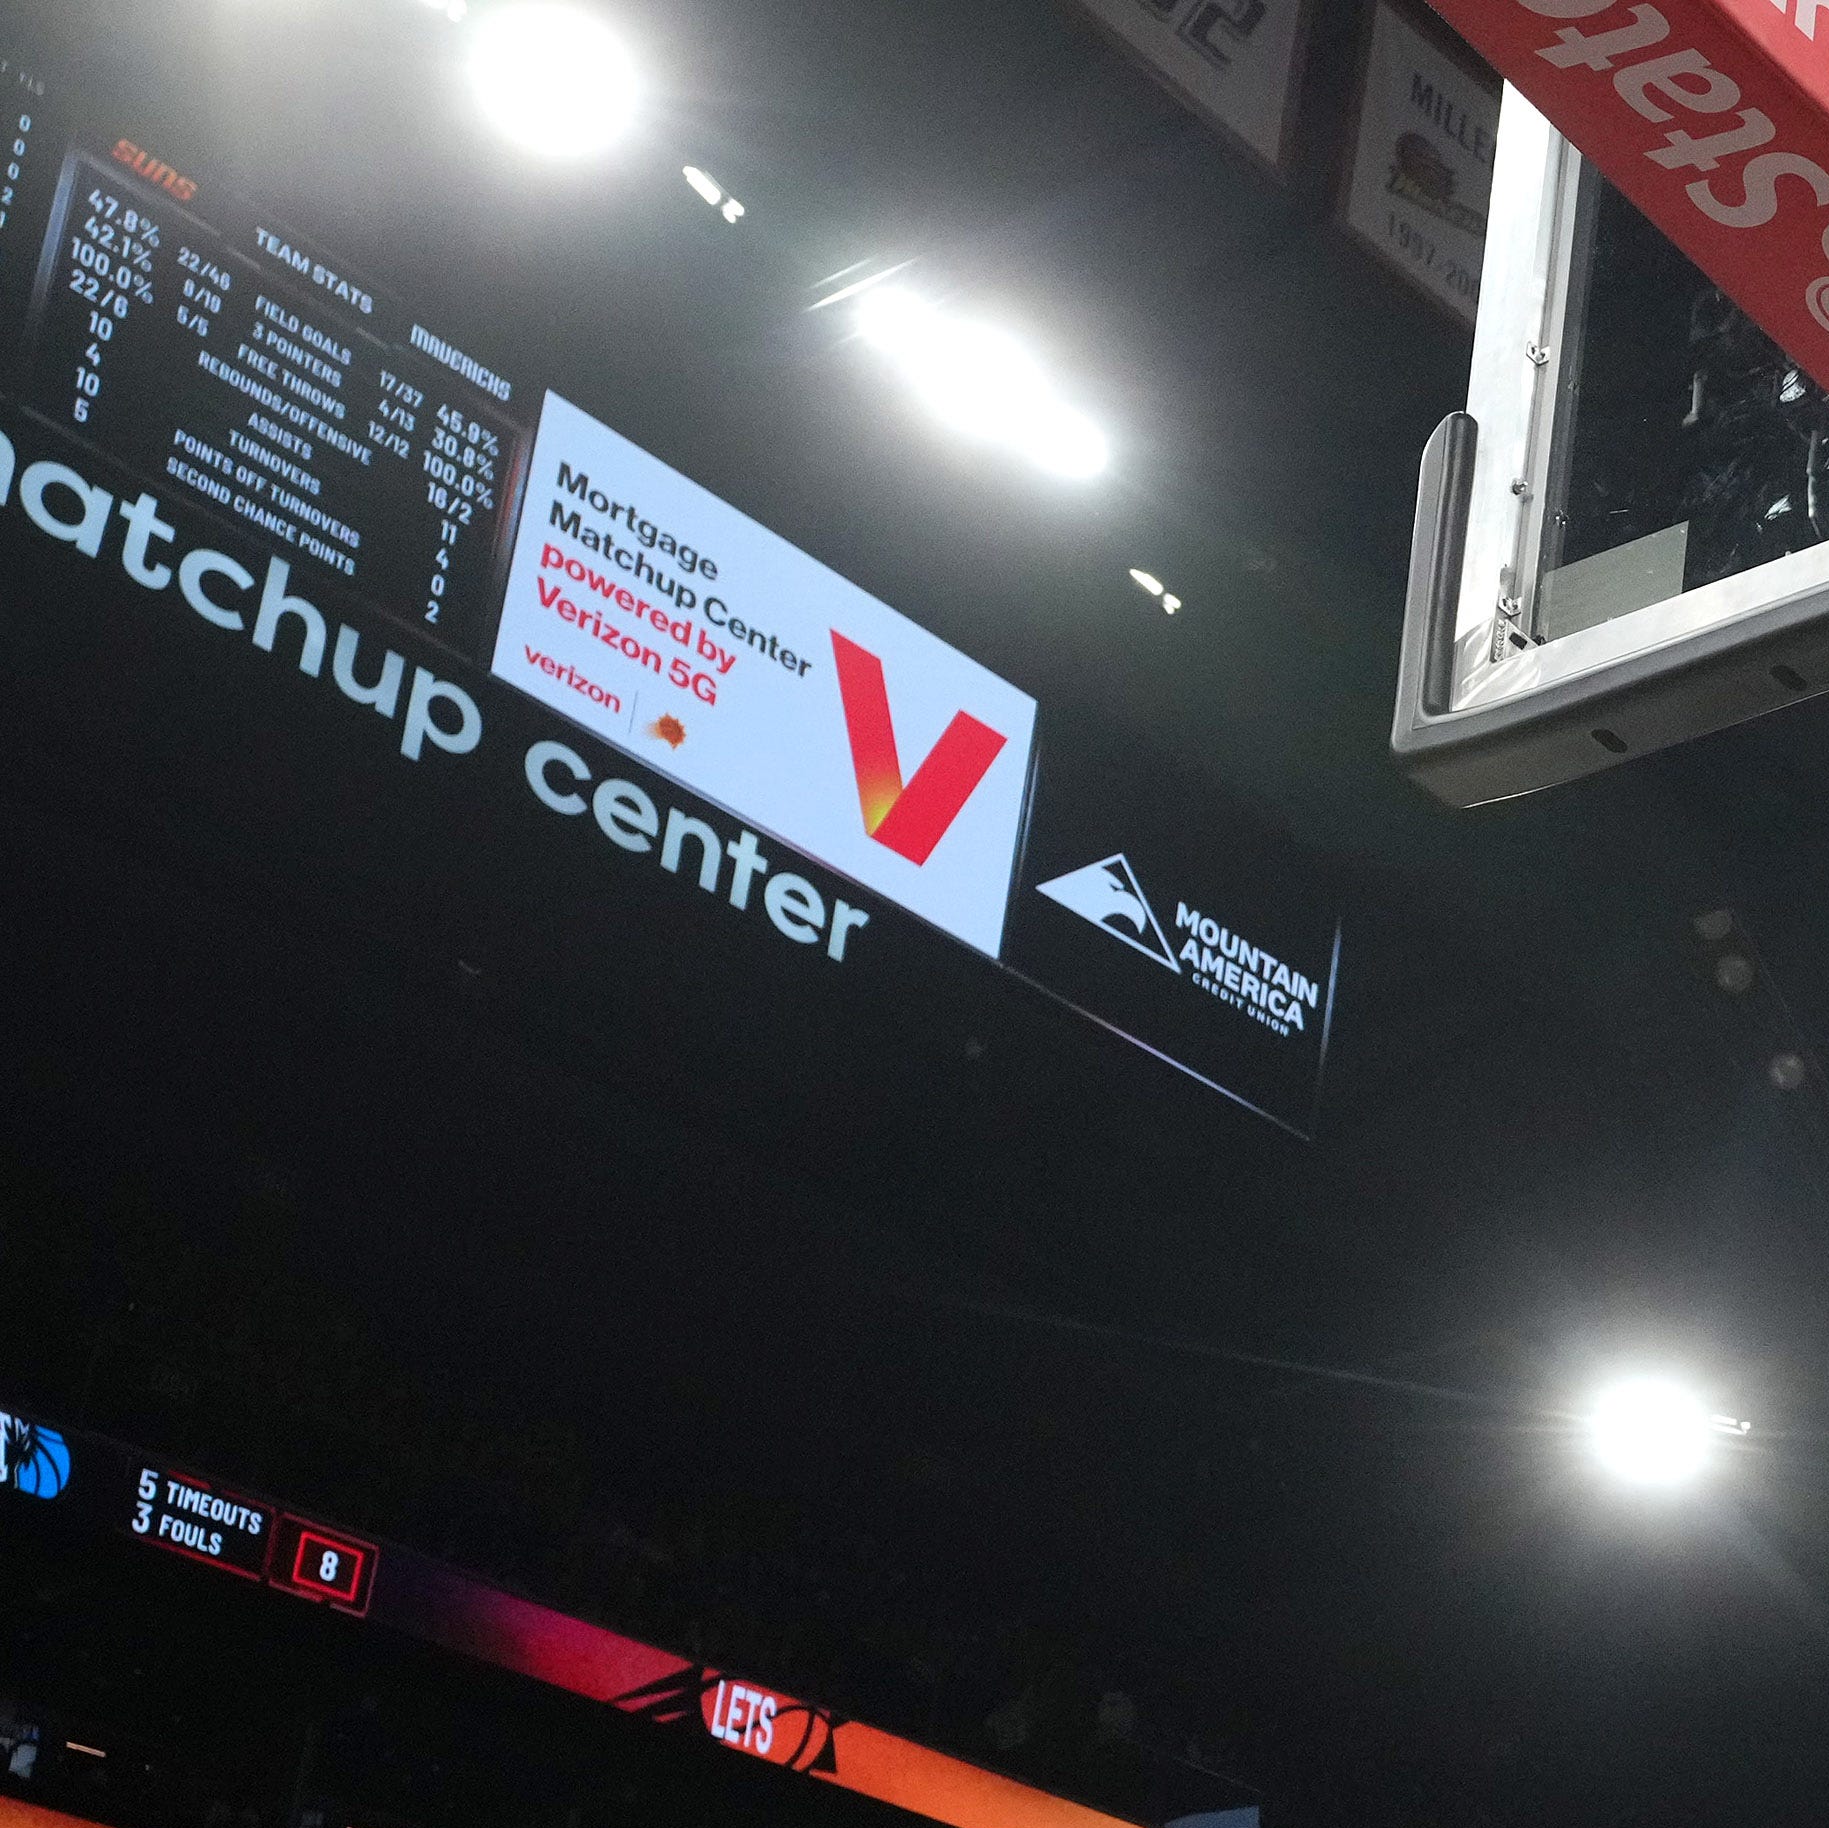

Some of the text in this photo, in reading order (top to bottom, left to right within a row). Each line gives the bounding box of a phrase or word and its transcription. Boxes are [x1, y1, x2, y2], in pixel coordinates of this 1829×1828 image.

[7, 162, 19, 180] 0
[13, 138, 25, 156] 0
[19, 114, 31, 132] 0
[84, 216, 152, 272] 42.1%
[266, 331, 342, 388] POINTERS
[256, 226, 372, 314] TEAM STATS
[72, 236, 494, 510] 100.0% FREE THROWS 12/12 100.0%
[255, 295, 299, 333] FIELD
[302, 325, 351, 365] GOALS
[380, 370, 424, 409] 17/37
[76, 366, 445, 597] 10 POINTS OFF TURNOVERS 0
[85, 343, 450, 570] 4 TURNOVERS 4
[89, 311, 458, 545] 10 ASSISTS 11
[199, 351, 373, 466] REBOUNDS/OFFENSIVE
[428, 481, 473, 525] 16/2
[166, 456, 440, 624] SECOND CHANCE POINTS 2
[557, 461, 719, 582] Mortgage
[537, 575, 720, 708] Verizon 5G
[540, 542, 736, 675] powered by
[550, 499, 812, 679] Matchup Center
[0, 428, 869, 963] atchup center
[525, 644, 621, 714] verizon
[1176, 901, 1318, 1010] MOUNTAIN
[1179, 938, 1305, 1032] AMERICA
[1192, 972, 1290, 1037] CREDIT UNION
[132, 1501, 223, 1556] 3 FOULS
[138, 1468, 263, 1535] 5 TIMEOUTS
[319, 1550, 339, 1582] 8
[711, 1680, 776, 1754] LETS
